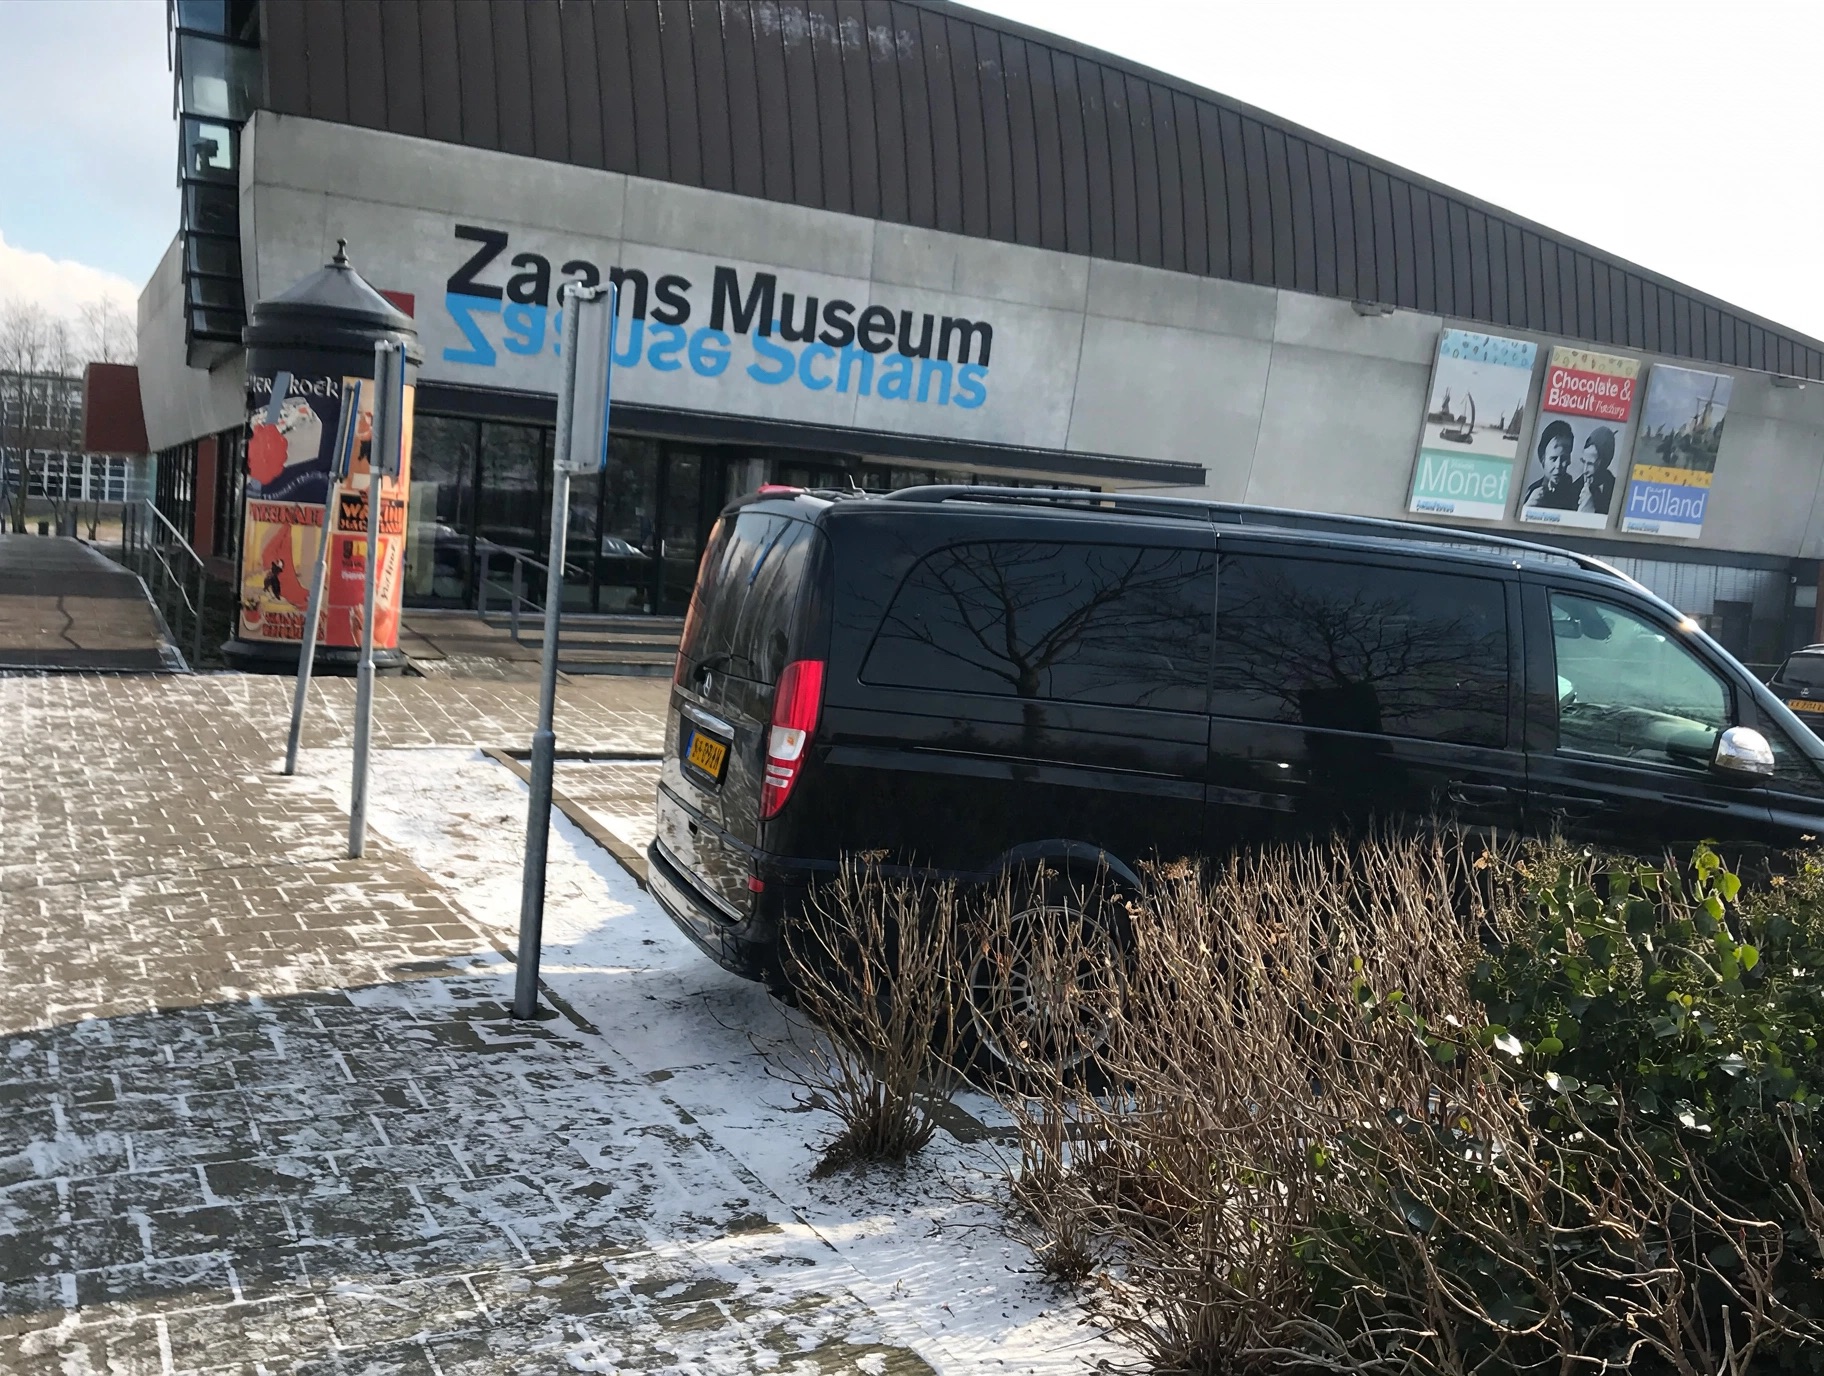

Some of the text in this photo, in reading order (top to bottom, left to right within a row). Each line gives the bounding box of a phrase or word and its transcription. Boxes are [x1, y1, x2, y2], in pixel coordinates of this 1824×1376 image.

[447, 224, 994, 367] Zaans Museum
[747, 319, 990, 409] Schans
[1552, 369, 1631, 402] Chocolate &
[1420, 457, 1508, 500] Monet
[1630, 485, 1706, 519] Holland
